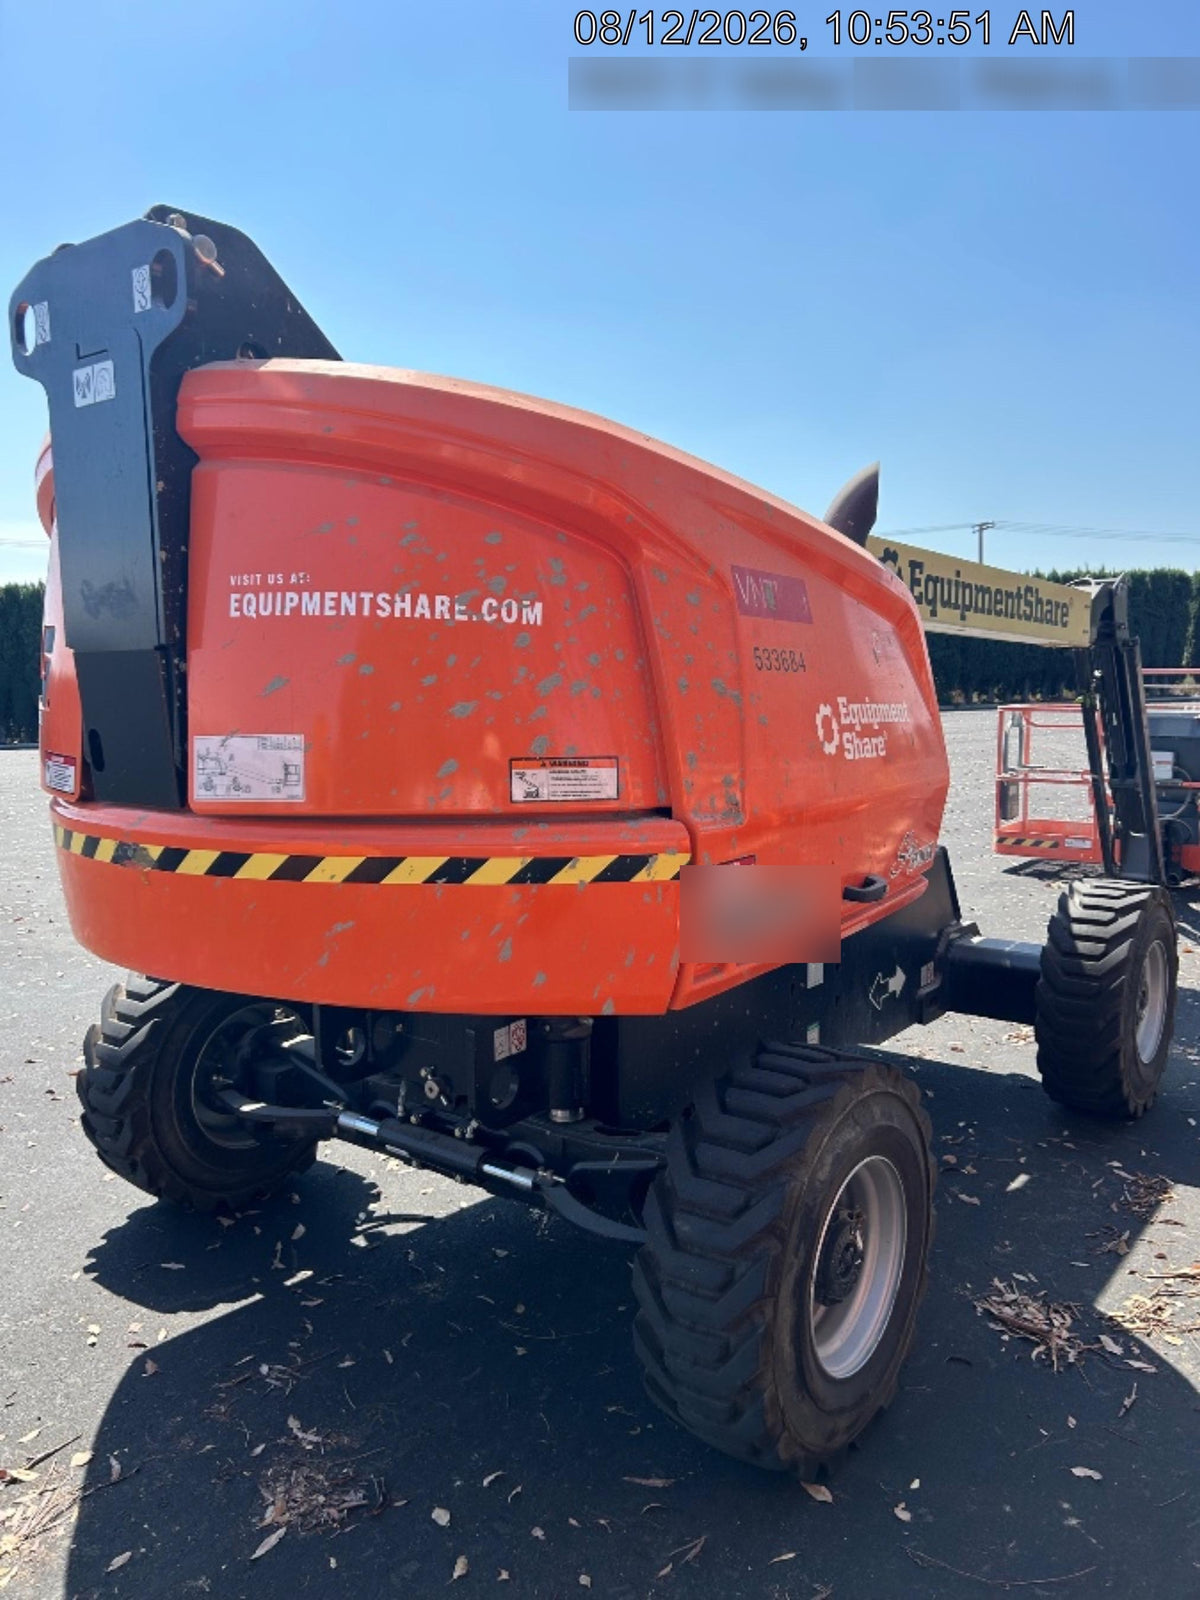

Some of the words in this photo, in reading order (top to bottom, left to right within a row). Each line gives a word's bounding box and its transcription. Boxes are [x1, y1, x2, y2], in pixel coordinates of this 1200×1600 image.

[229, 573, 262, 586] VISIT
[267, 573, 284, 585] US
[907, 559, 1071, 628] EquipmentShare
[229, 591, 544, 627] EQUIPMENTSHARE.COM
[836, 695, 910, 732] Equipment
[842, 731, 887, 761] Share
